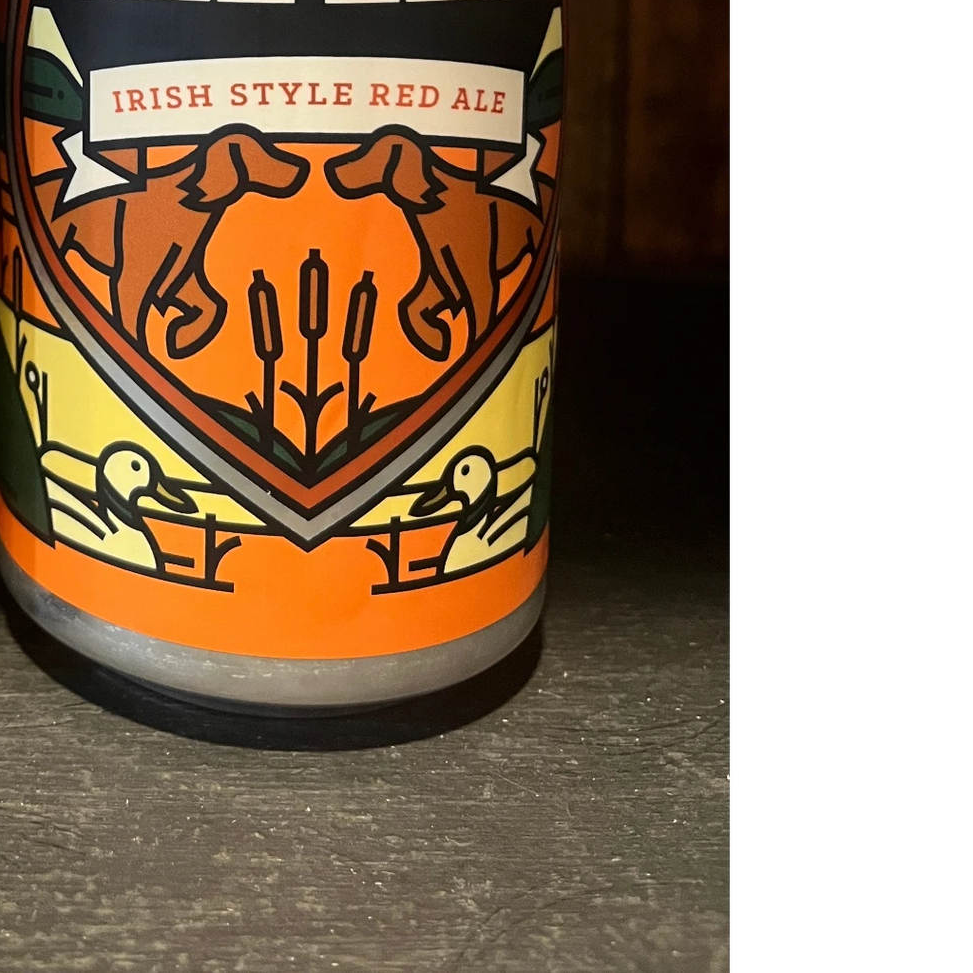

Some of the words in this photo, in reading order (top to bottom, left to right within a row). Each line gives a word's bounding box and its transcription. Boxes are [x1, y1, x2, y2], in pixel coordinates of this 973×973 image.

[112, 84, 213, 114] IRISH
[230, 81, 354, 107] STYLE
[368, 82, 441, 108] RED
[451, 87, 507, 114] ALE
